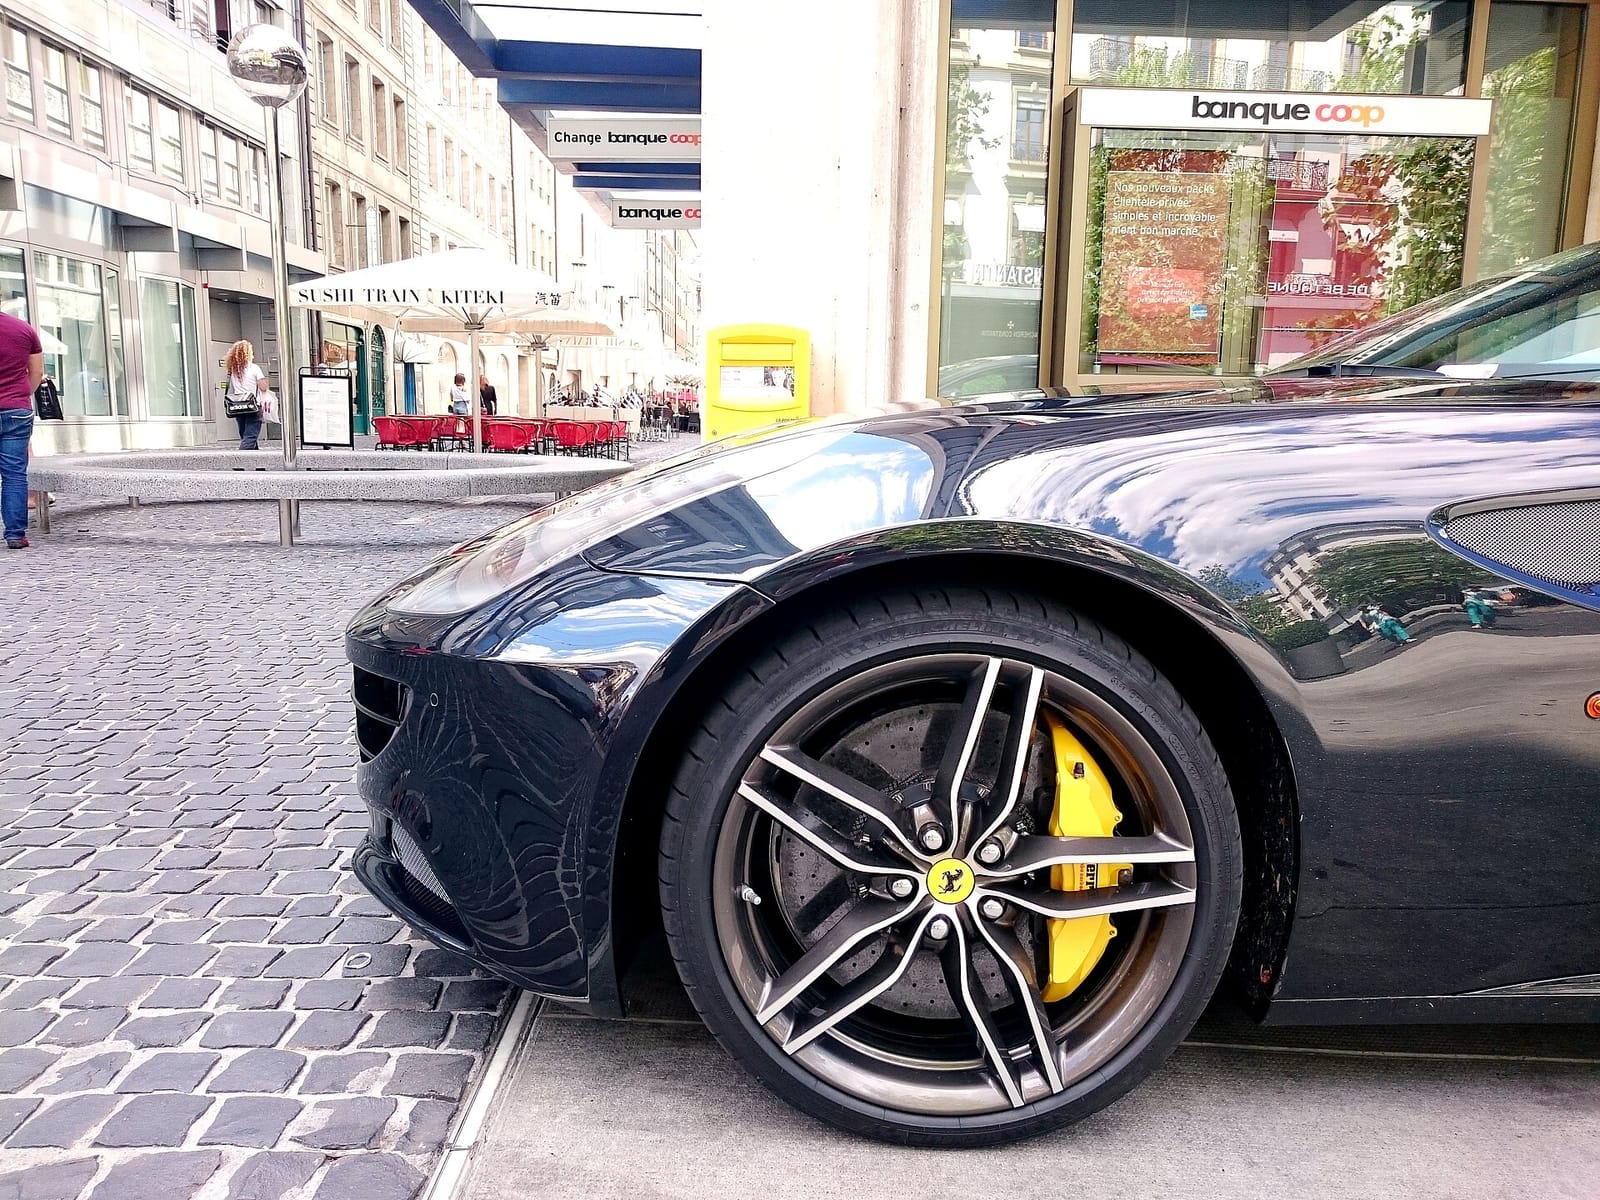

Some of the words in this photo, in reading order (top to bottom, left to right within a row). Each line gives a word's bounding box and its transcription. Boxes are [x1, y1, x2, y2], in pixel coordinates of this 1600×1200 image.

[1191, 95, 1311, 125] banque
[1315, 103, 1385, 128] coop
[554, 131, 602, 145] Change
[608, 131, 667, 145] banque
[1114, 182, 1135, 193] Nos
[1136, 184, 1183, 193] nouveaux
[1186, 184, 1215, 195] packs
[618, 205, 683, 221] banque
[684, 208, 701, 218] co
[1112, 210, 1149, 221] simples
[1152, 211, 1162, 221] et
[1111, 226, 1136, 236] ment
[1140, 225, 1158, 235] bon
[299, 288, 353, 302] SUSHI
[363, 288, 419, 302] TRAIN
[442, 290, 504, 304] KITEKI
